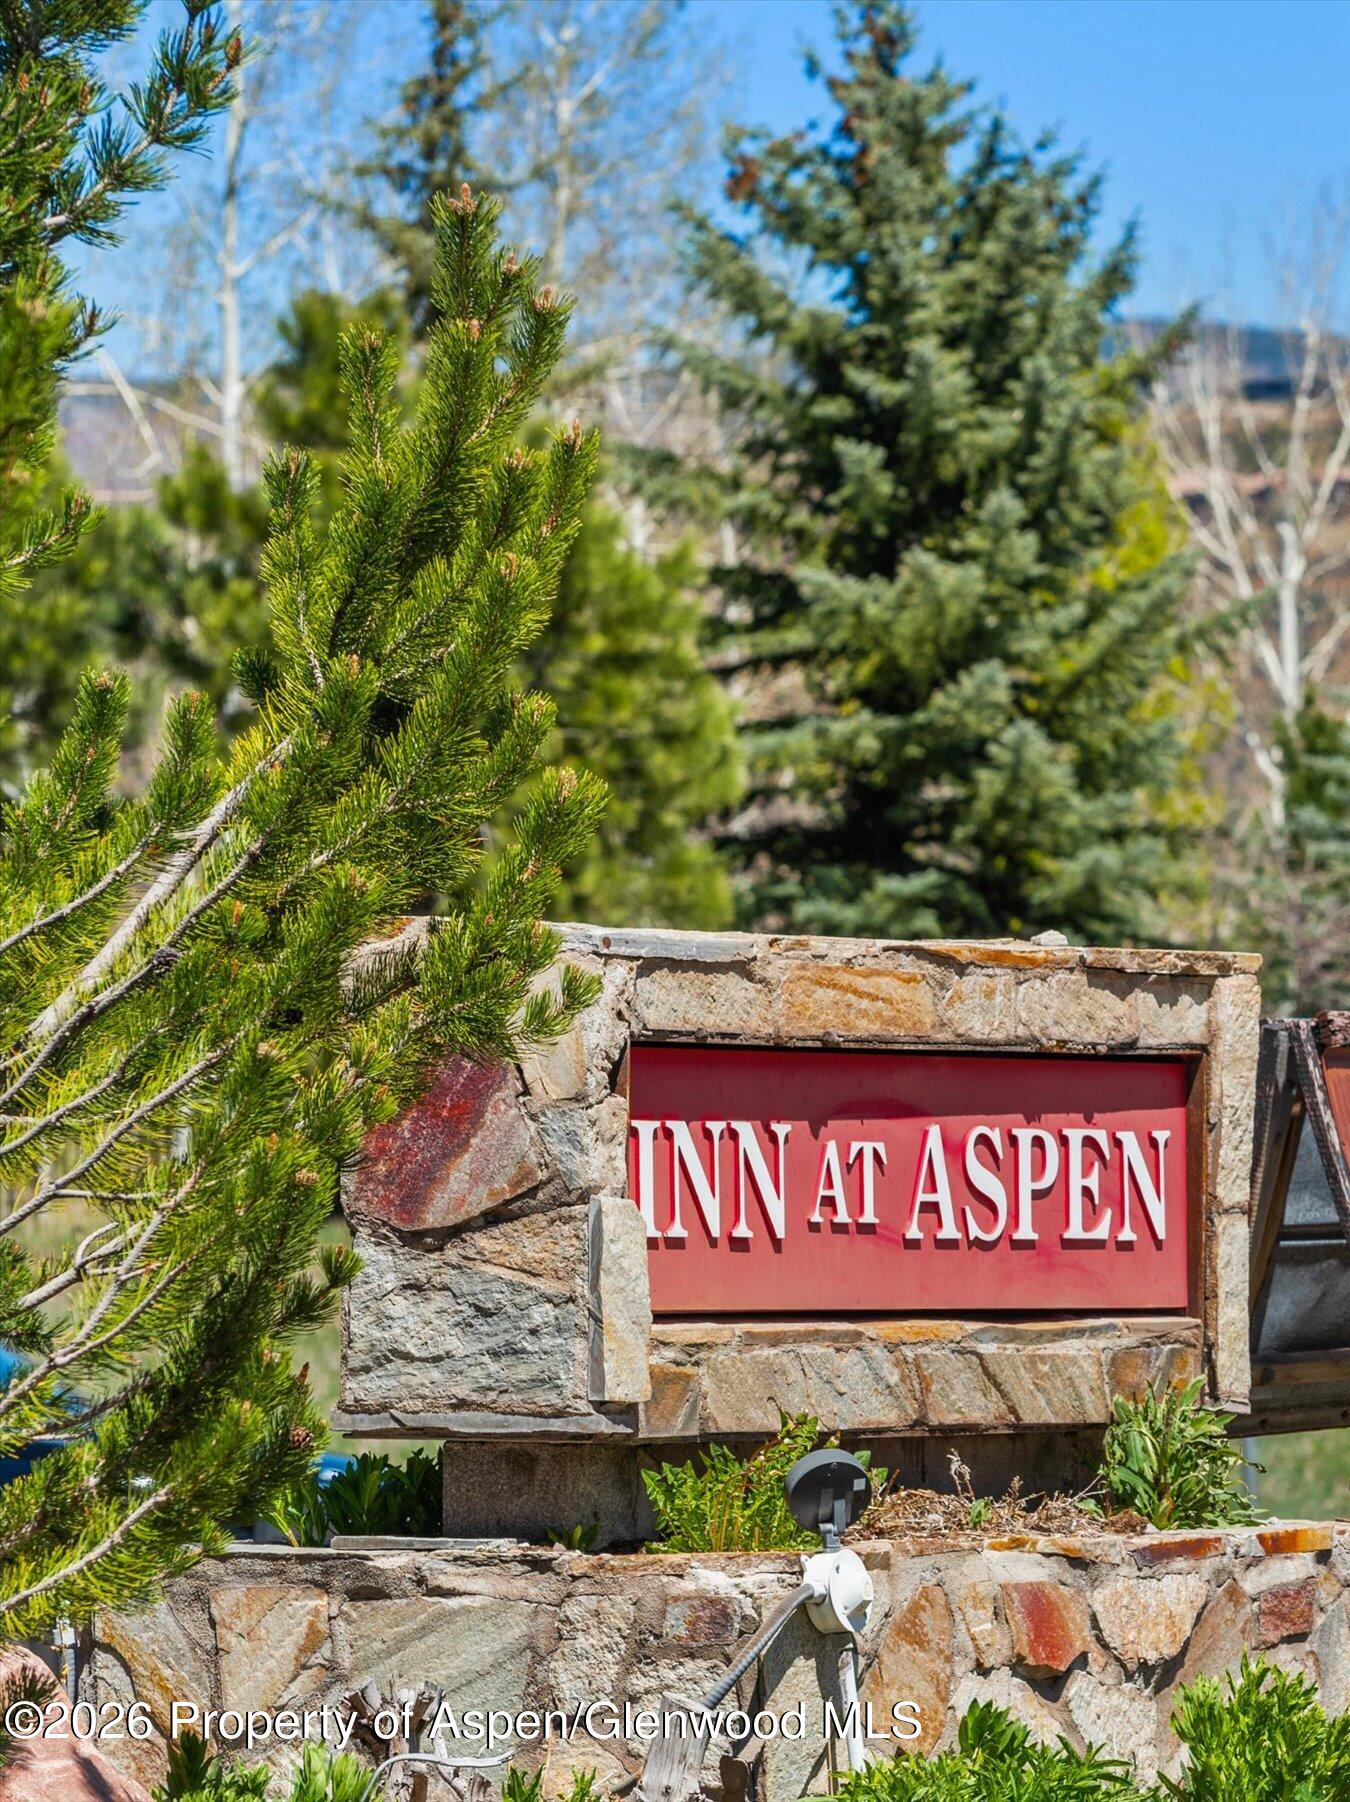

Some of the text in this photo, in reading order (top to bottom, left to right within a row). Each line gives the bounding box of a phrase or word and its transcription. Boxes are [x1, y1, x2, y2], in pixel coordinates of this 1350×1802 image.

[631, 1120, 1170, 1241] INN AT ASPEN
